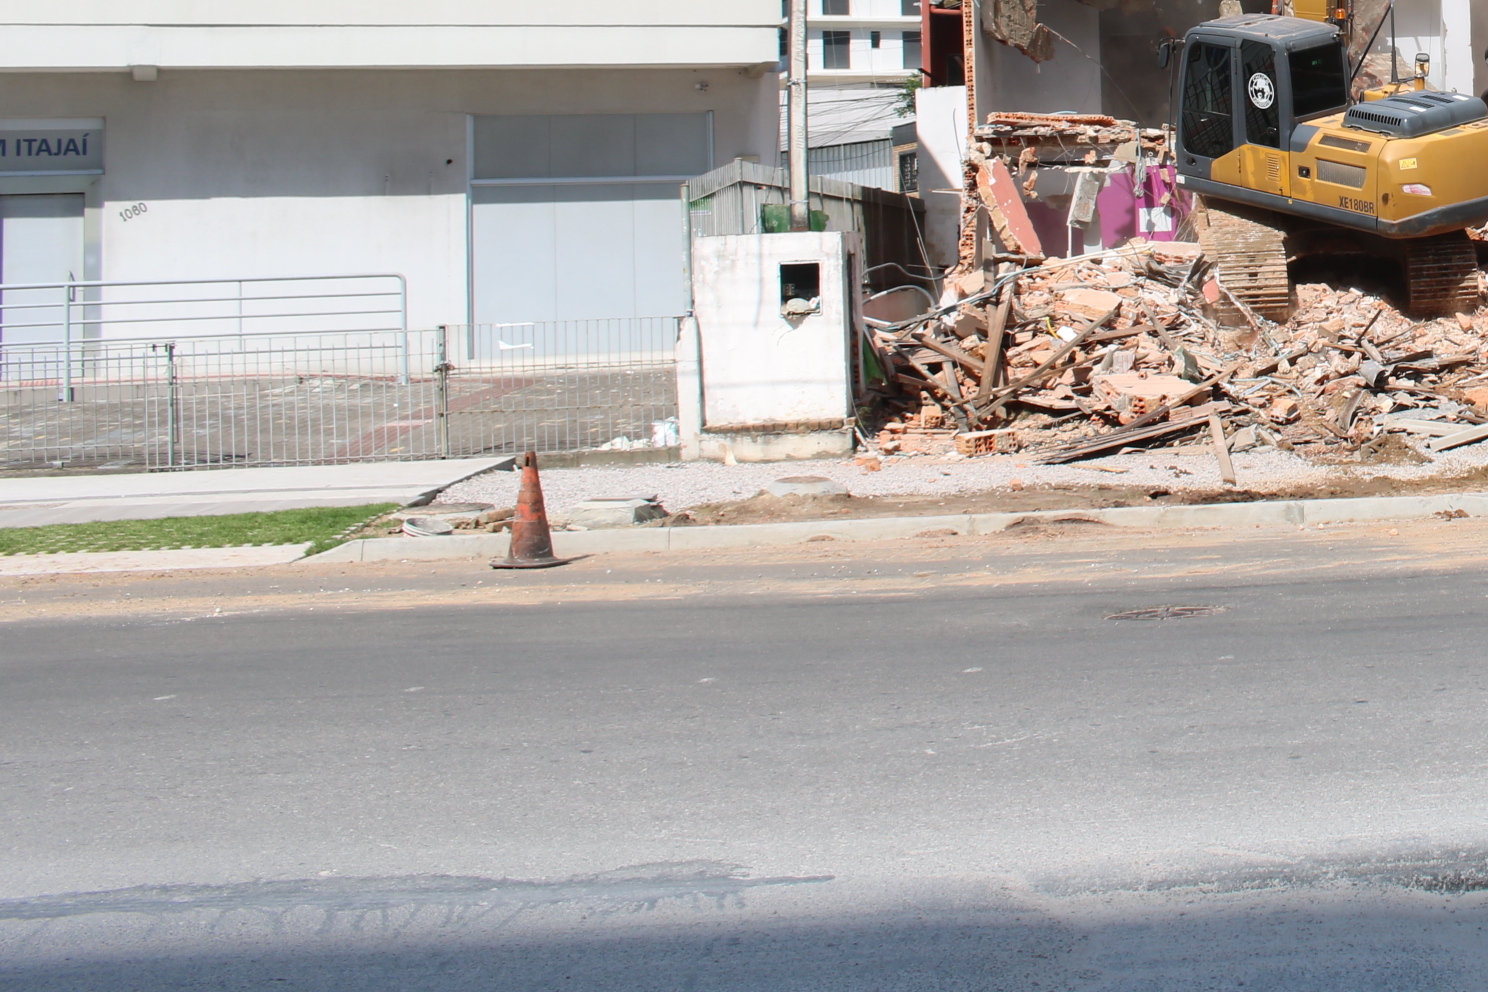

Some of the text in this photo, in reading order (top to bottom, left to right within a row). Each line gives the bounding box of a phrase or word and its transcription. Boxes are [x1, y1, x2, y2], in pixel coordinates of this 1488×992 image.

[15, 132, 90, 157] ITAJAÍ
[119, 202, 148, 222] 1080
[1338, 195, 1375, 215] XE180BR
